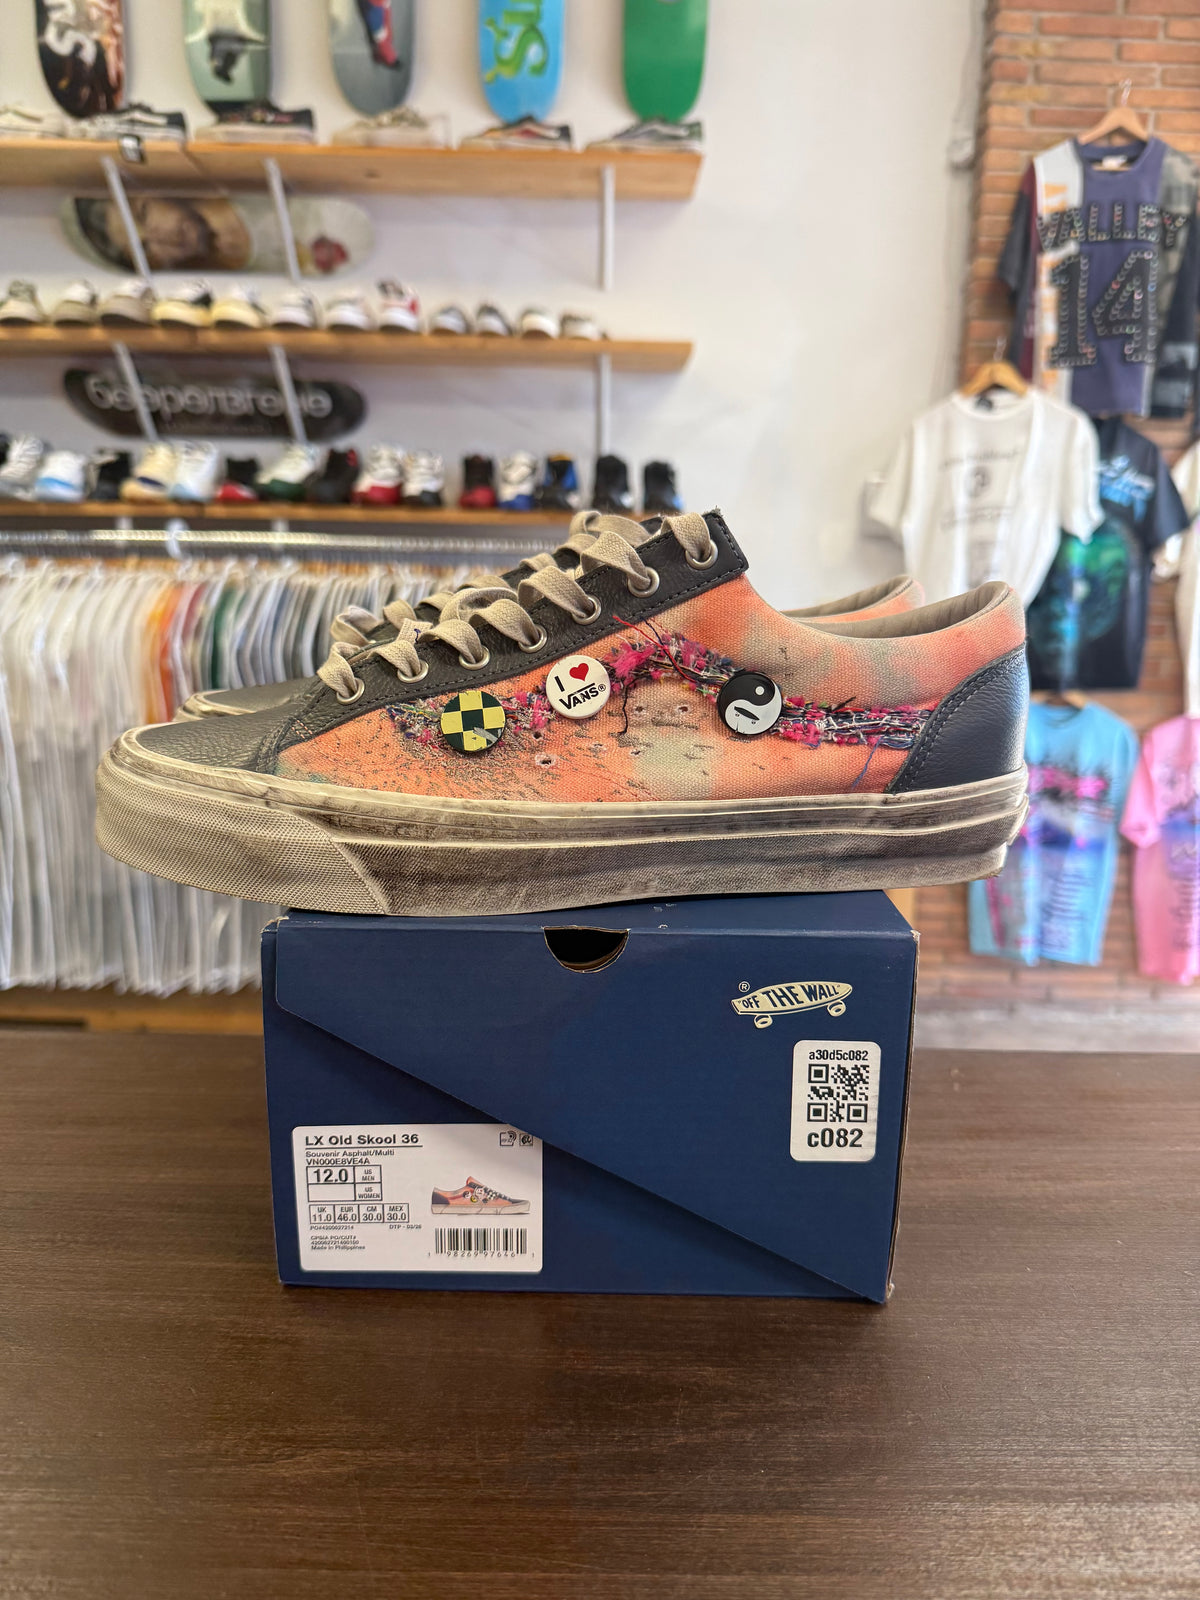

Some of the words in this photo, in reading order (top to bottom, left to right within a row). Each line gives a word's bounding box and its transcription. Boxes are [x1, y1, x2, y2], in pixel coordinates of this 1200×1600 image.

[1036, 202, 1187, 251] VALLEY
[1047, 250, 1161, 368] 14
[554, 675, 565, 692] I
[762, 985, 804, 1008] THE
[808, 1049, 869, 1061] a30d5c082
[305, 1135, 324, 1146] LX
[328, 1135, 352, 1146] Old
[357, 1134, 396, 1145] Skool
[401, 1133, 419, 1144] 36
[807, 1127, 864, 1148] c082
[305, 1150, 341, 1158] Souvenir
[342, 1149, 395, 1158] Asphalt/Multi
[313, 1168, 349, 1183] 12.0
[312, 1214, 332, 1222] 11.0
[337, 1213, 357, 1222] 46.0
[362, 1213, 382, 1221] 30.0
[386, 1212, 407, 1221] 30.0
